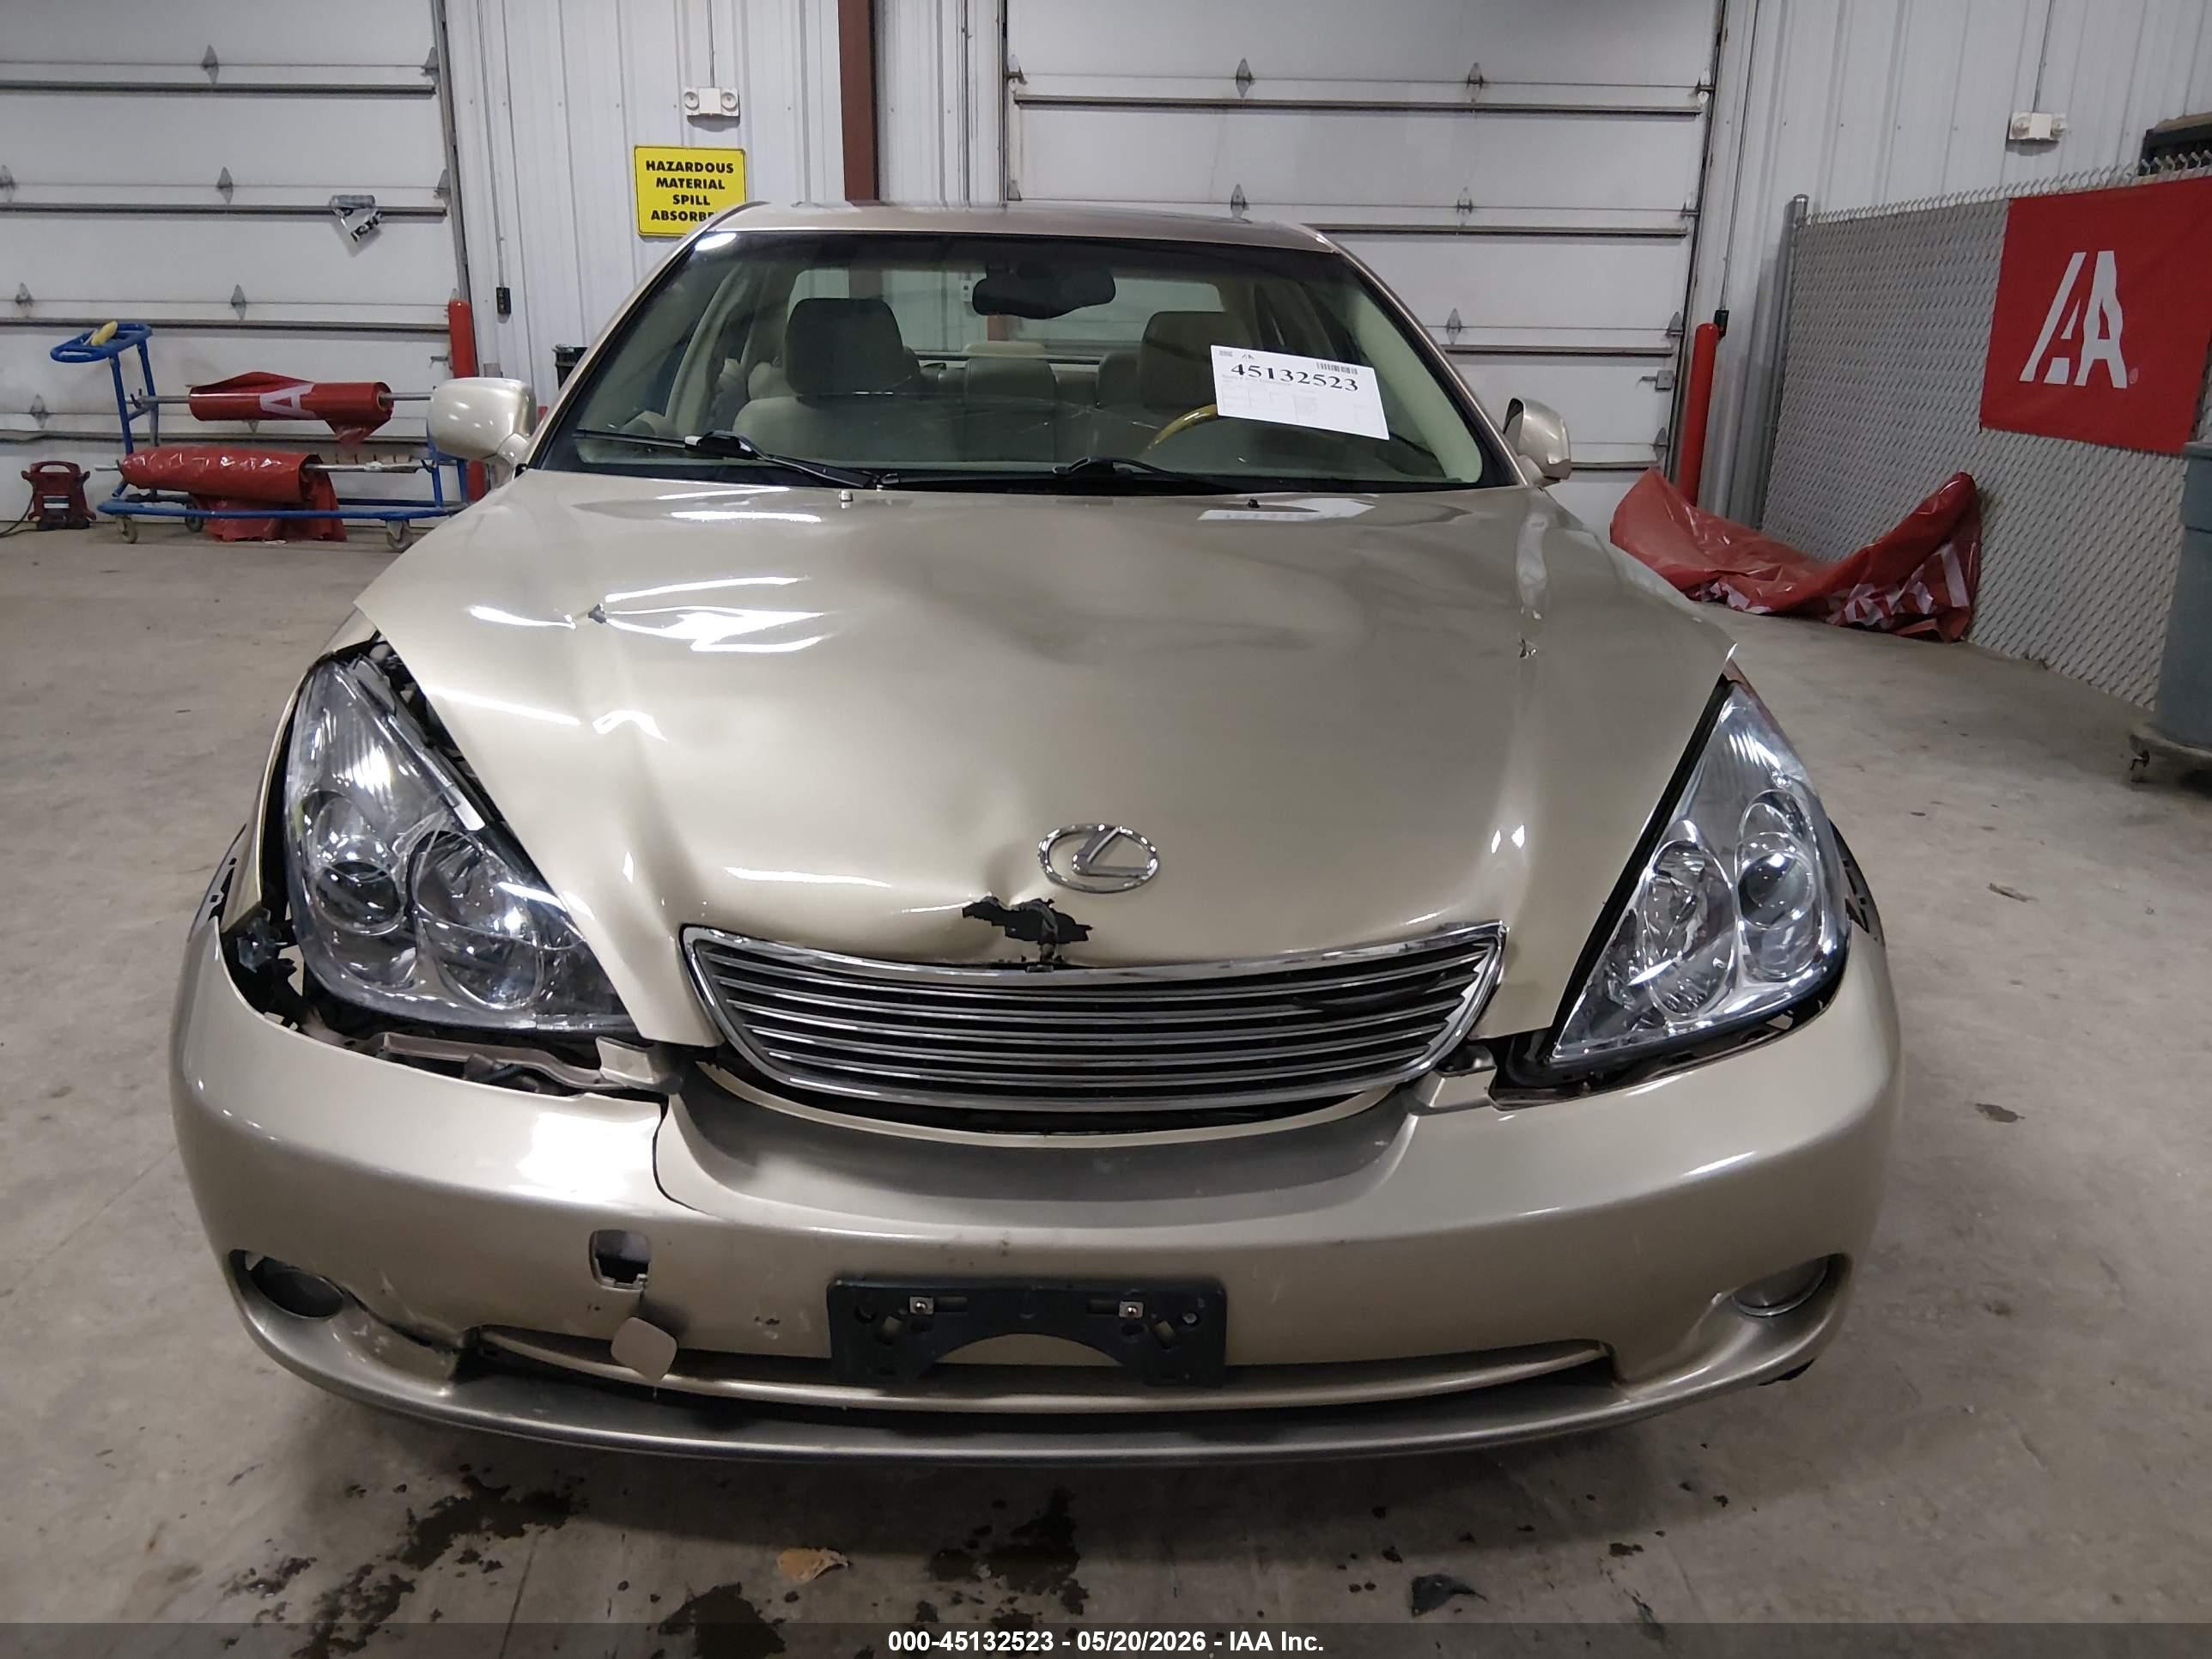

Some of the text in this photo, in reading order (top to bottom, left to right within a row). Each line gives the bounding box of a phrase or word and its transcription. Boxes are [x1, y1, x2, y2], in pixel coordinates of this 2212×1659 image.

[646, 160, 734, 173] HAZARDOUS
[655, 177, 726, 190] MATERIAL
[672, 194, 711, 206] SPILL
[1231, 363, 1358, 392] 45132523
